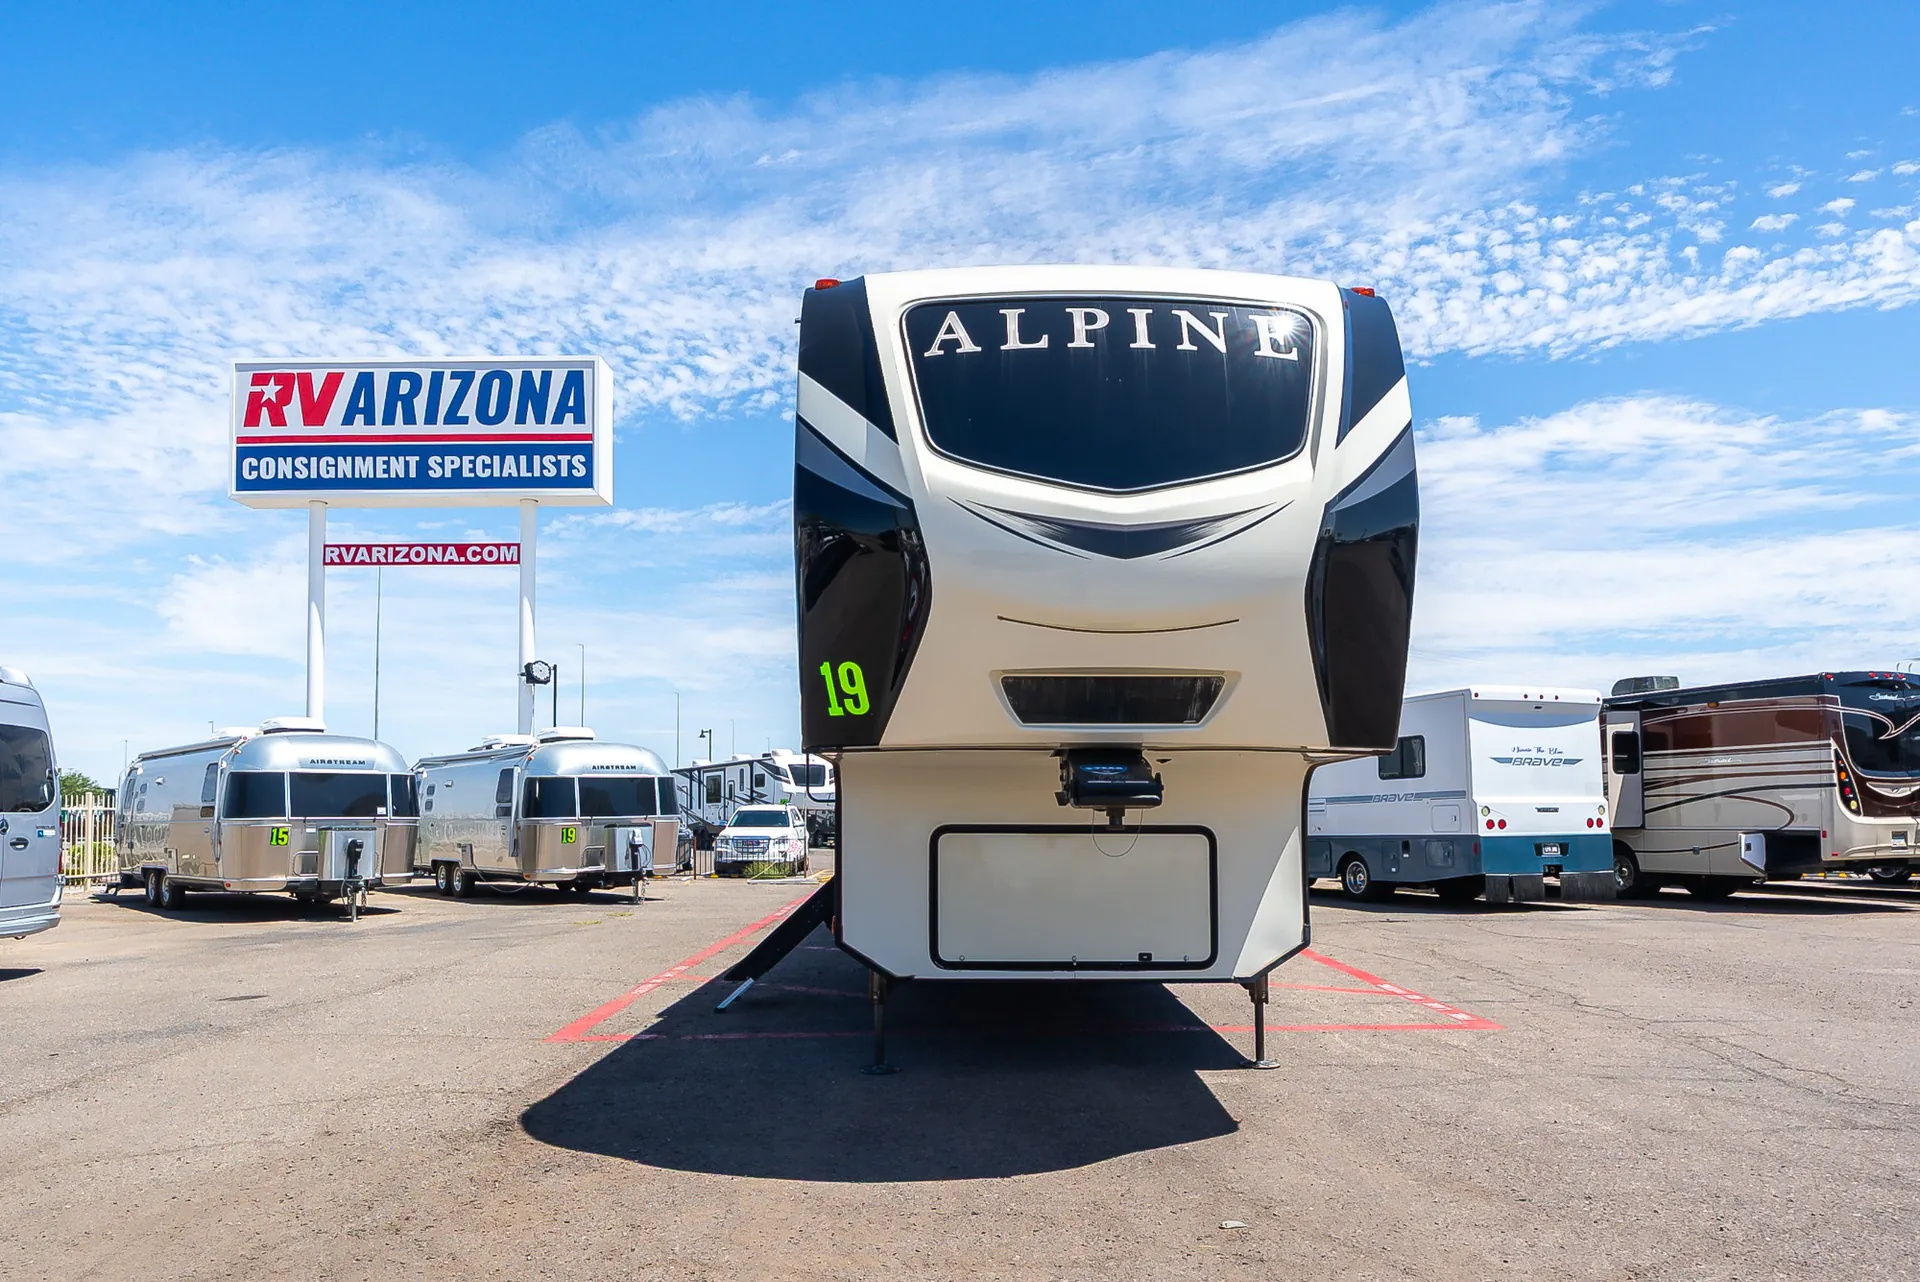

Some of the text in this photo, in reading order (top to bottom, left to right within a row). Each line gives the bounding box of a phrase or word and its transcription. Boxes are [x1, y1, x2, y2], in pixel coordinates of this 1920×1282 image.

[924, 307, 1299, 361] ALPINE
[243, 369, 586, 428] RV ARIZONA
[242, 453, 587, 480] CONSIGNMENT SPECIALISTS
[325, 544, 519, 564] RVARIZONA.COM
[819, 660, 870, 717] 19
[309, 758, 366, 766] AIRSTREAM
[1511, 757, 1563, 767] BRAVE
[1372, 792, 1415, 803] BRAVE
[270, 827, 289, 847] 15
[561, 827, 577, 844] 19
